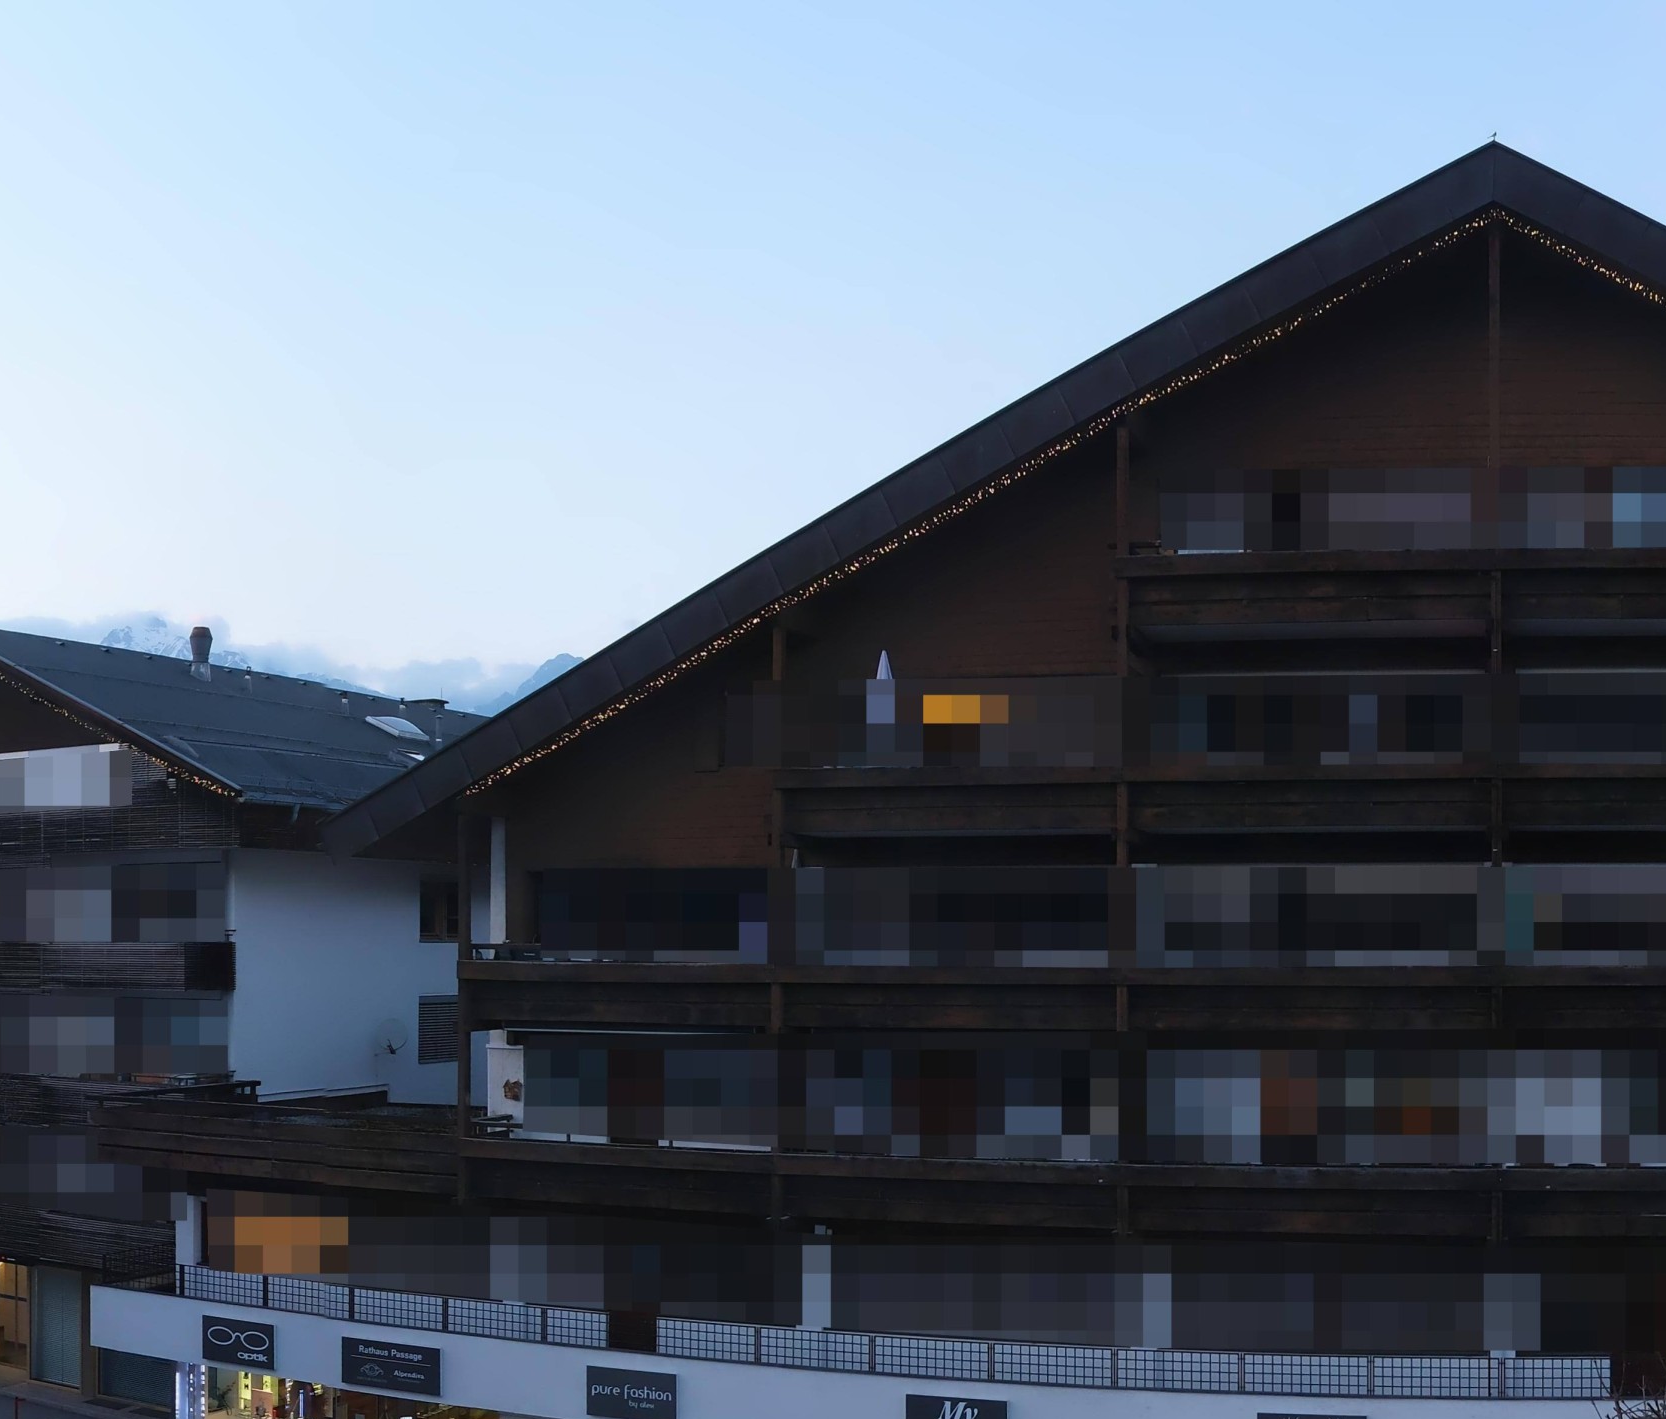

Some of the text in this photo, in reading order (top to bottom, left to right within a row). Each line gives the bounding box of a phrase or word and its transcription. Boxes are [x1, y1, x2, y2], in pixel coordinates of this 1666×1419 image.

[237, 1351, 269, 1362] optik
[358, 1344, 422, 1361] Rathaus Passage
[393, 1369, 425, 1380] Alpendiva
[591, 1383, 672, 1401] pure fashion
[628, 1400, 638, 1409] by
